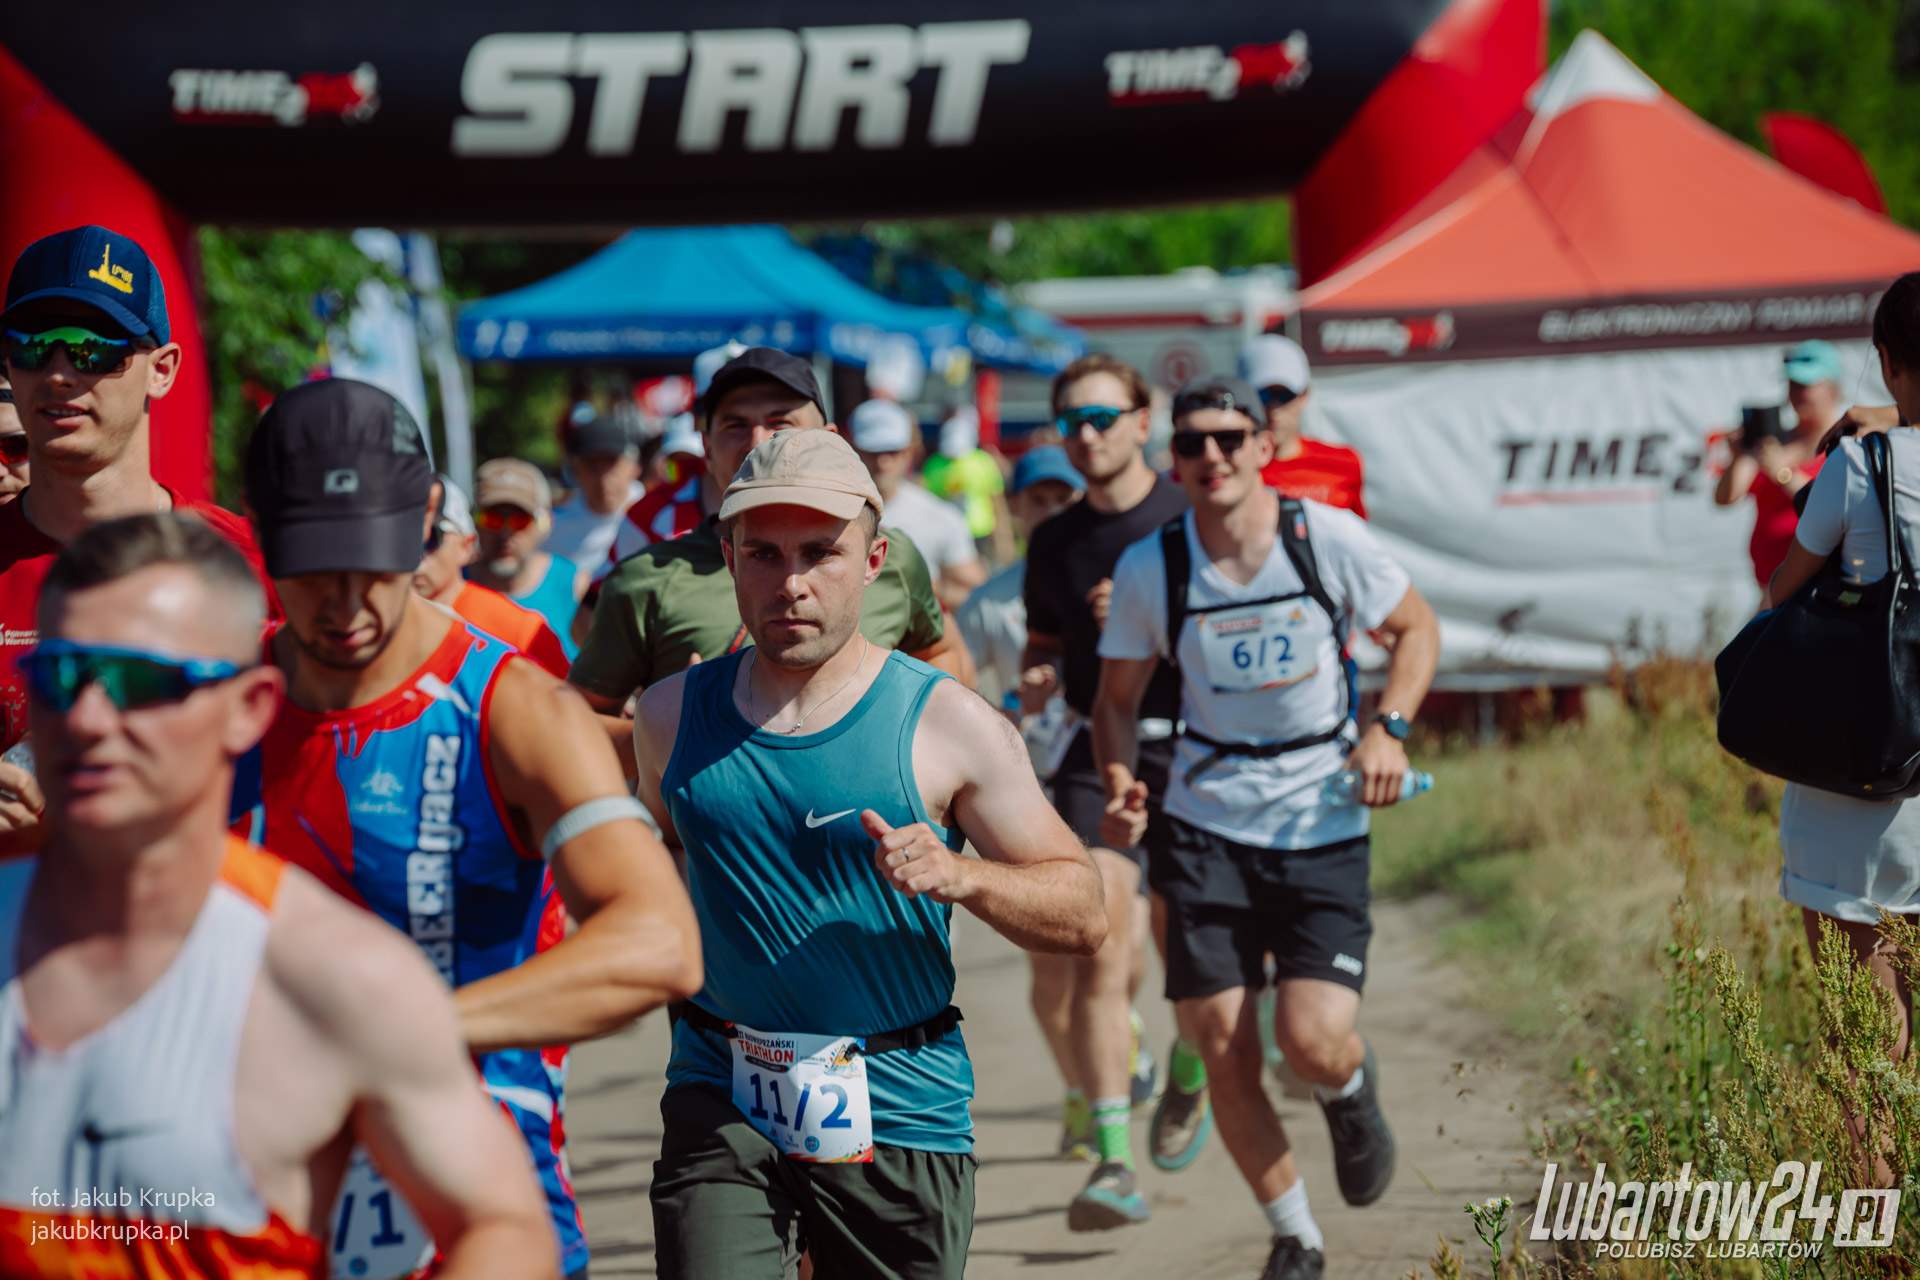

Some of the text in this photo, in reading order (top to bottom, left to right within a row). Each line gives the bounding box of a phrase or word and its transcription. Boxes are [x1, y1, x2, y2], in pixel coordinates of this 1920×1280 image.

[452, 19, 1030, 157] START
[1232, 635, 1295, 670] 6/2
[738, 1040, 794, 1062] TRIATHLON
[750, 1073, 852, 1131] 11/2
[335, 1189, 404, 1253] /1
